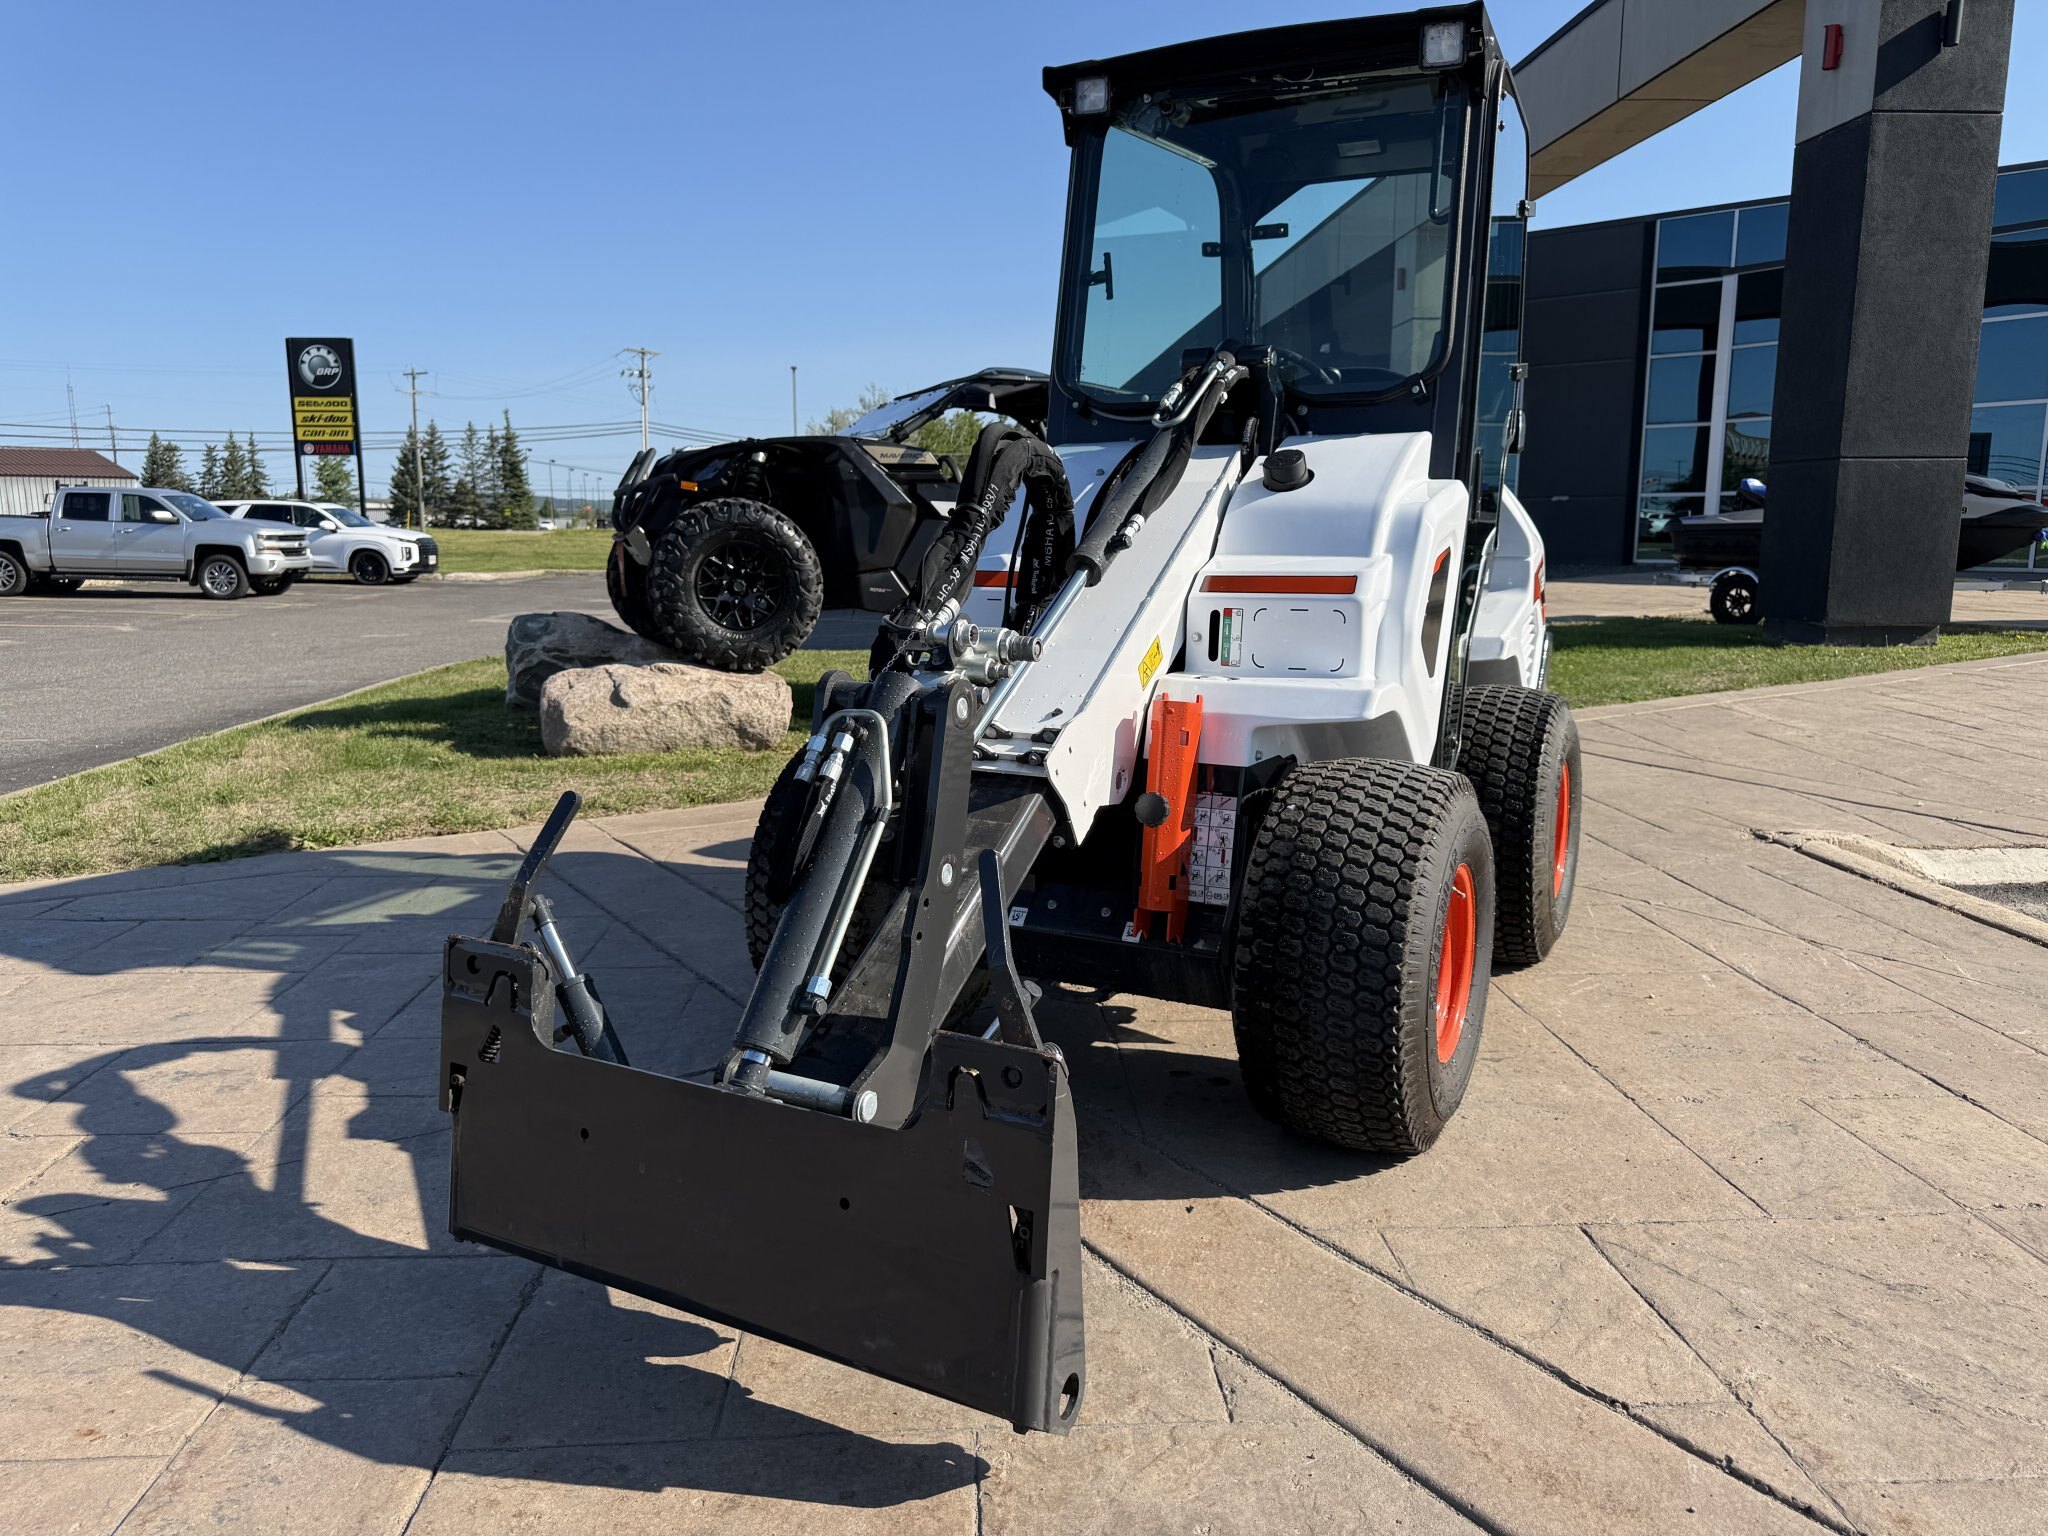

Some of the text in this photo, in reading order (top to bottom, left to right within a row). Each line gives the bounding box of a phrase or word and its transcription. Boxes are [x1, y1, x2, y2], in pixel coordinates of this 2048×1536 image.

[316, 367, 339, 375] BRP
[301, 414, 348, 424] ski-doo
[302, 429, 349, 437] can-am
[315, 444, 350, 453] YAMAHA
